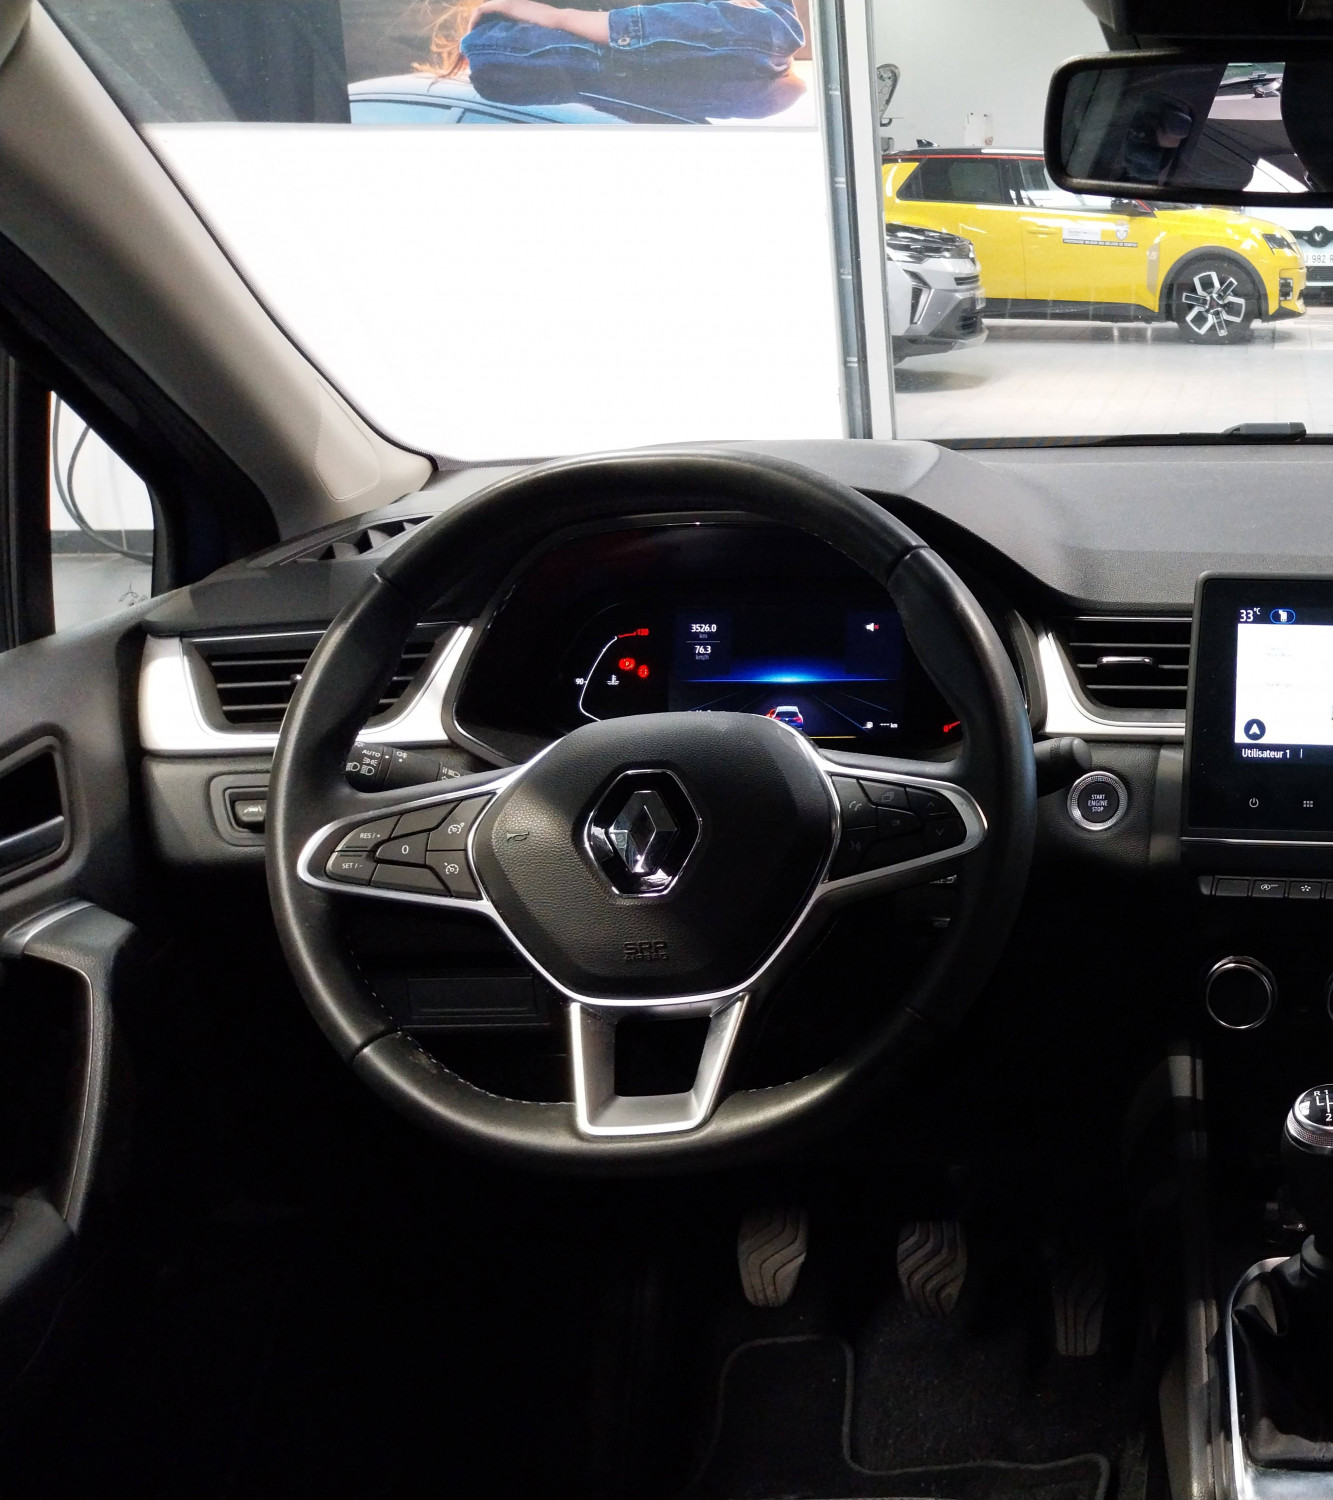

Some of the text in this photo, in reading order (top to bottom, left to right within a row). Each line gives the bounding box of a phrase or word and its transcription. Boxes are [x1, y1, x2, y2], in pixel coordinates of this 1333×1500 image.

[691, 623, 717, 632] 3526.0
[694, 645, 712, 654] 76.3
[362, 749, 381, 757] AUTO
[1242, 748, 1290, 759] Utilisateur 1
[1325, 1113, 1333, 1121] 2
